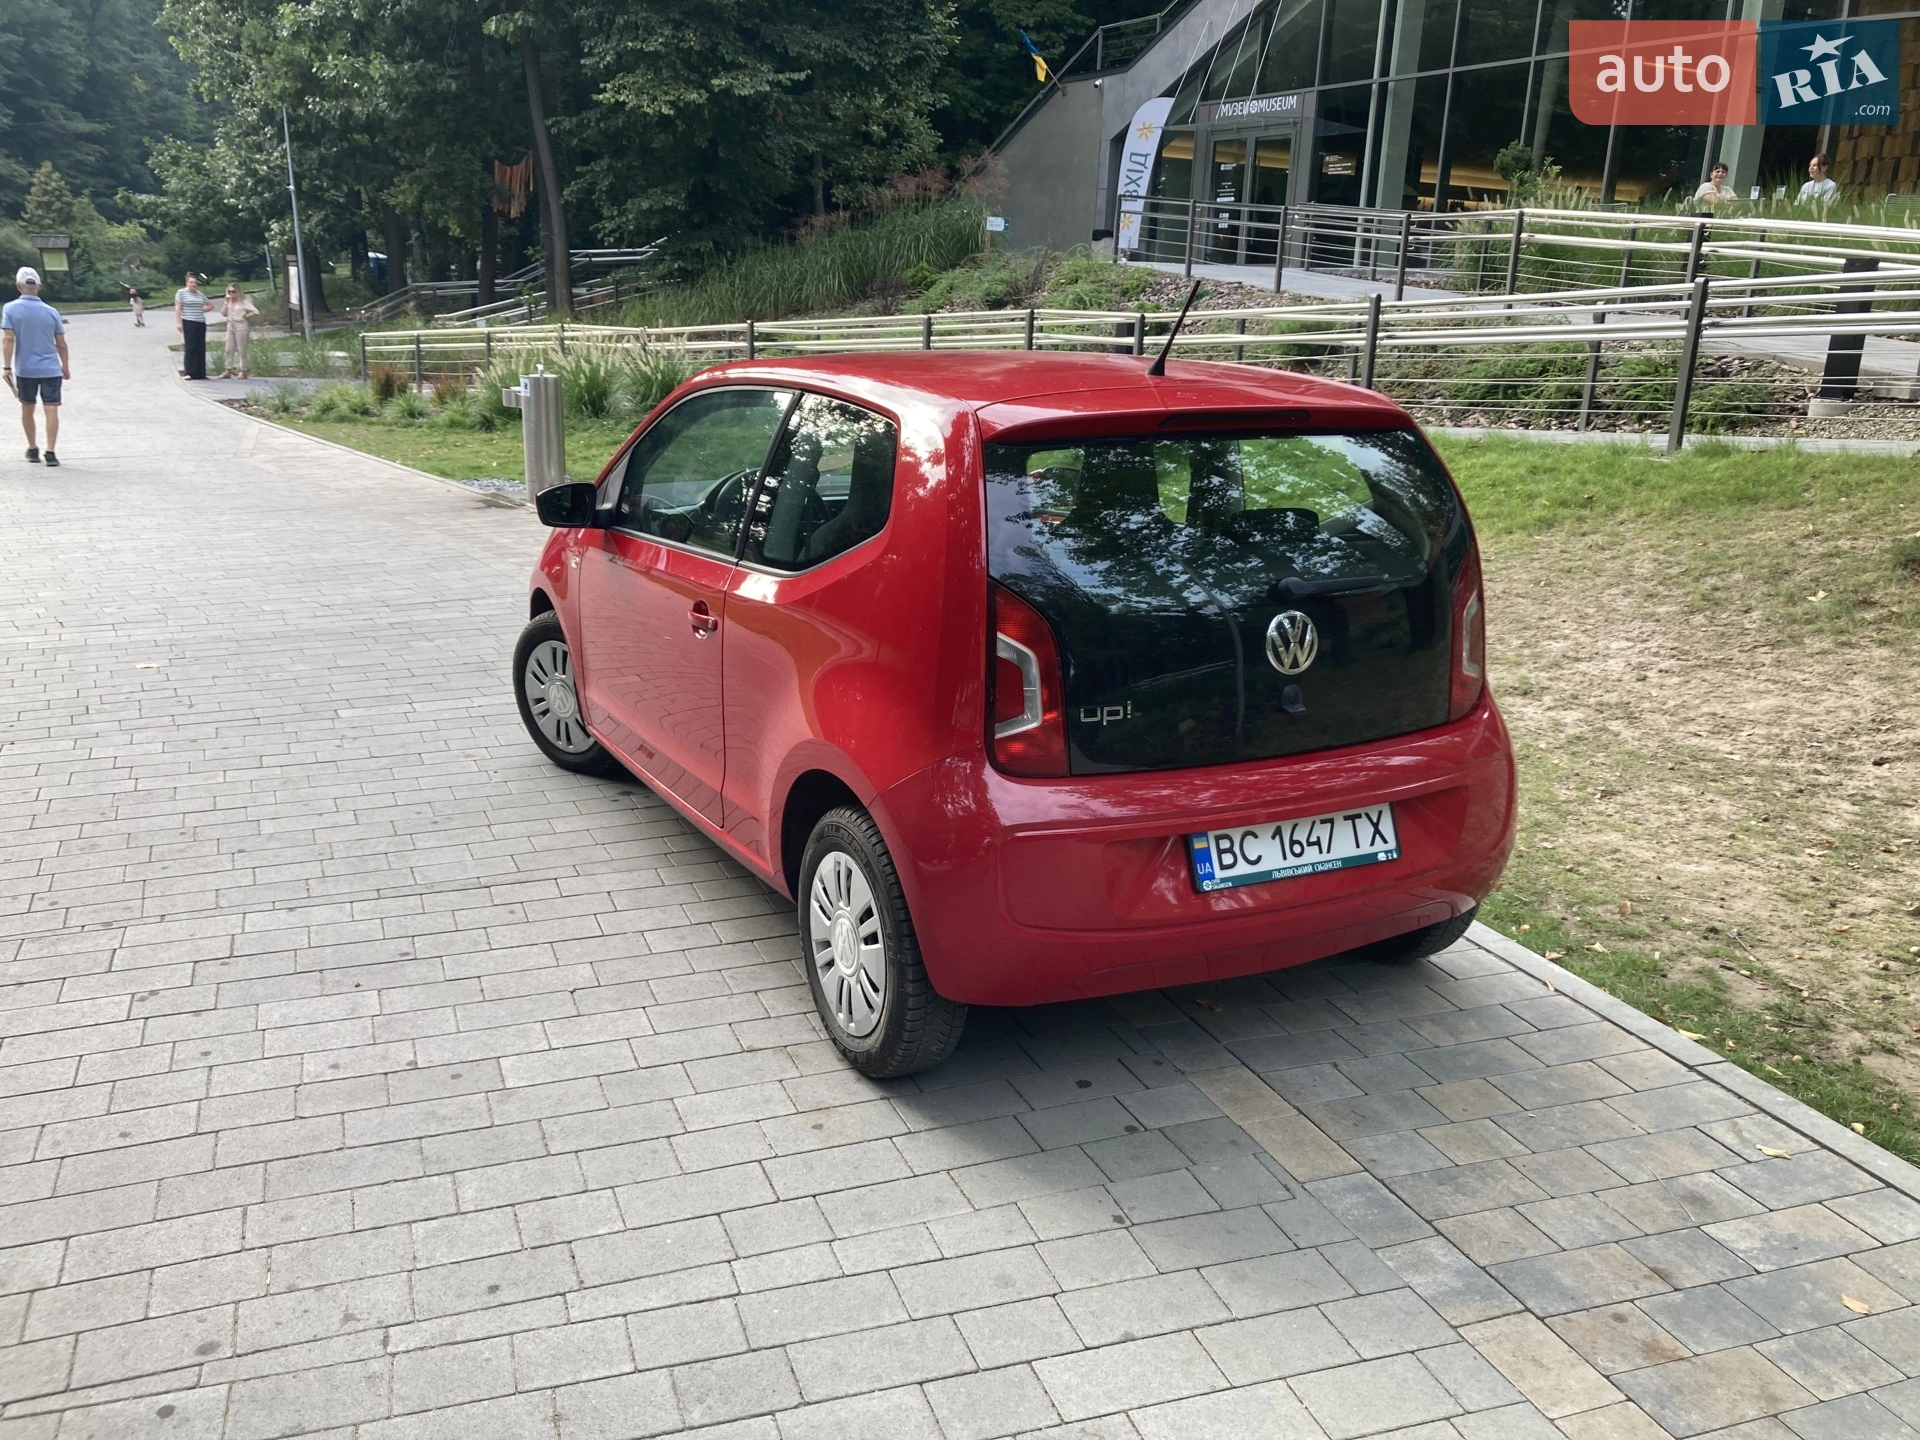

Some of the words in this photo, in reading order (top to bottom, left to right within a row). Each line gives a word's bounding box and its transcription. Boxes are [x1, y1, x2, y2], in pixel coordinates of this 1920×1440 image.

[1220, 100, 1250, 117] МУЗЕЙ
[1257, 95, 1297, 113] MUSEUM
[1123, 152, 1151, 202] ВХІД
[1080, 700, 1132, 725] up!
[1213, 830, 1262, 871] BC
[1271, 818, 1335, 861] 1647
[1343, 810, 1389, 849] TX
[1197, 862, 1213, 875] UA
